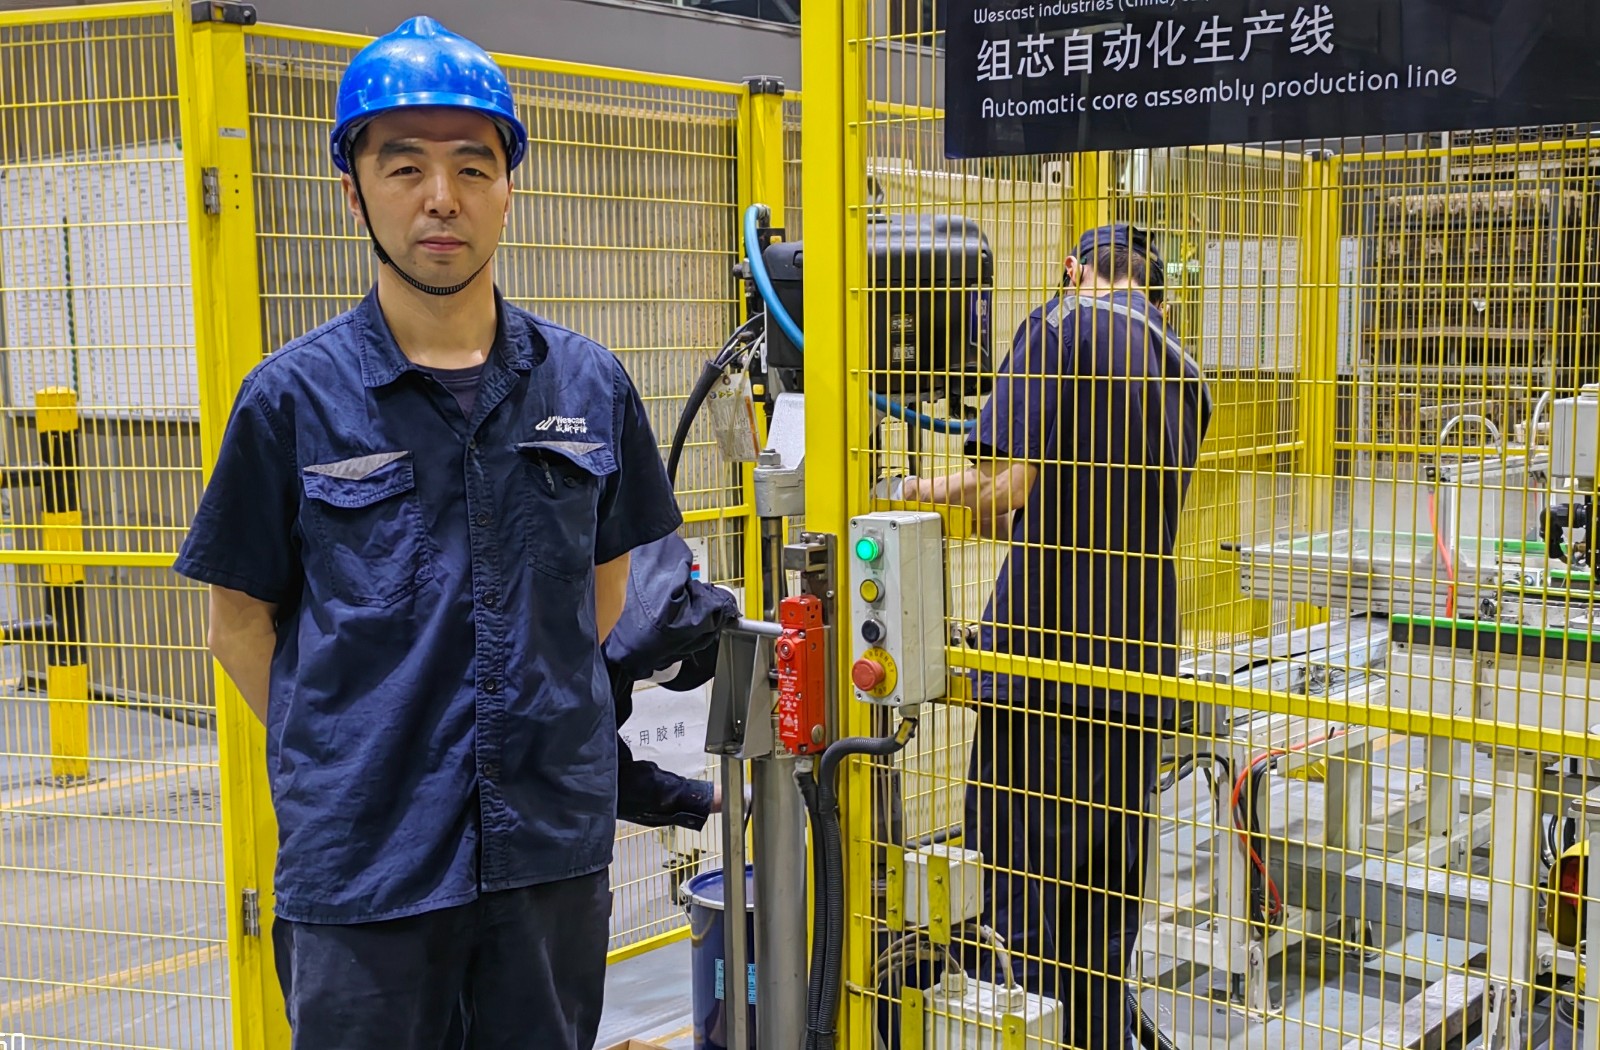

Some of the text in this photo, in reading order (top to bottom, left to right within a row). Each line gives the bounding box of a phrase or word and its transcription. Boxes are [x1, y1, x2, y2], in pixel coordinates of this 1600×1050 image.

[974, 5, 1035, 24] Wescast
[1039, 0, 1114, 17] industries
[976, 4, 1335, 81] 组芯自动化生产线
[982, 64, 1457, 118] Automatic core assembly production line
